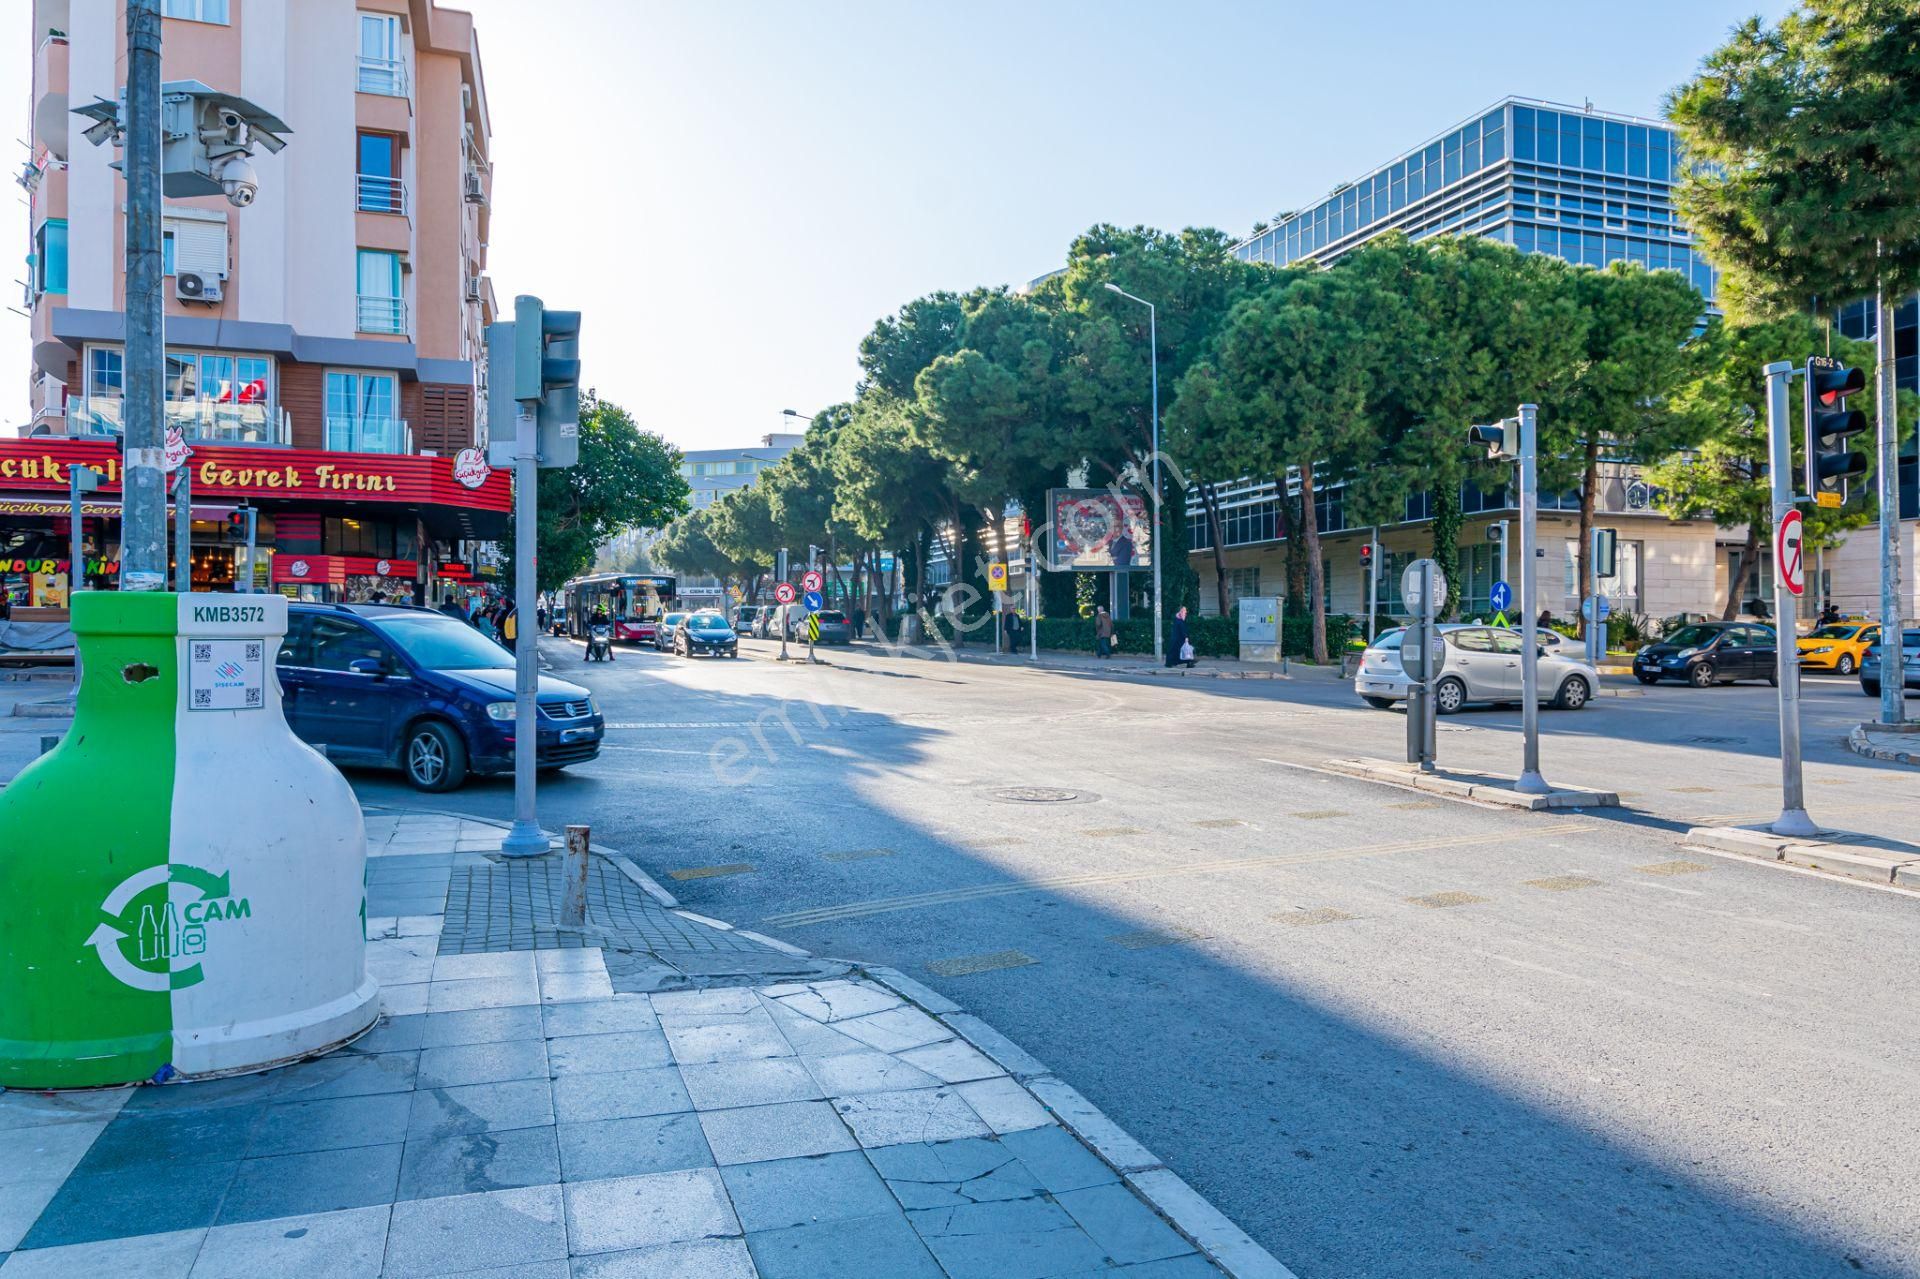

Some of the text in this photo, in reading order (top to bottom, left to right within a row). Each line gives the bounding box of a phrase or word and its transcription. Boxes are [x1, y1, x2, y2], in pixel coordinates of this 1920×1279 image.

[200, 461, 302, 488] Gevrek
[315, 464, 396, 491] Fırını
[194, 606, 264, 622] KMB3572
[184, 898, 251, 923] CAM
